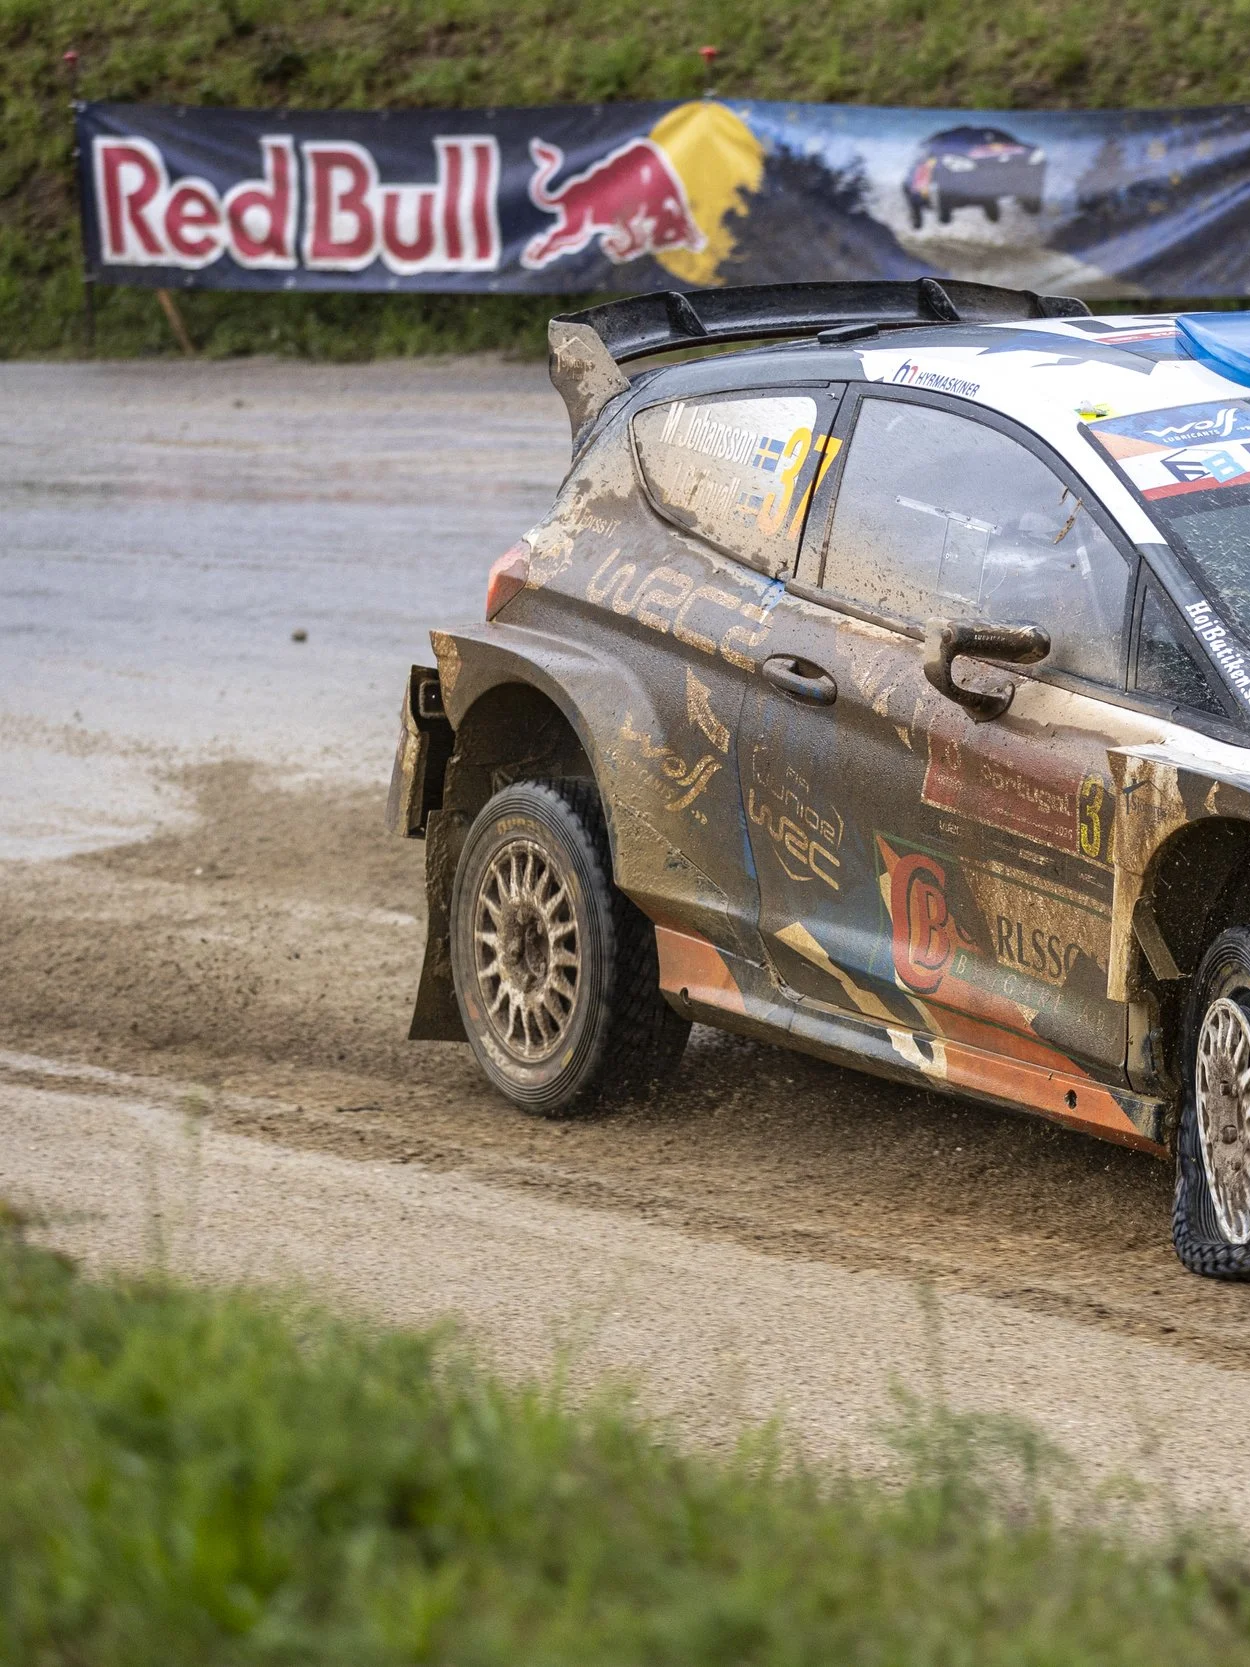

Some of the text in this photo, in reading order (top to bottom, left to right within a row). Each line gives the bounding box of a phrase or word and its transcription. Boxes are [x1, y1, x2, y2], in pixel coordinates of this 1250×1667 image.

[916, 371, 980, 397] HYRMASKINER
[660, 401, 759, 466] M Johansson
[1163, 429, 1220, 442] LUBRICANTS
[758, 427, 844, 541] 37
[749, 788, 841, 891] WRC
